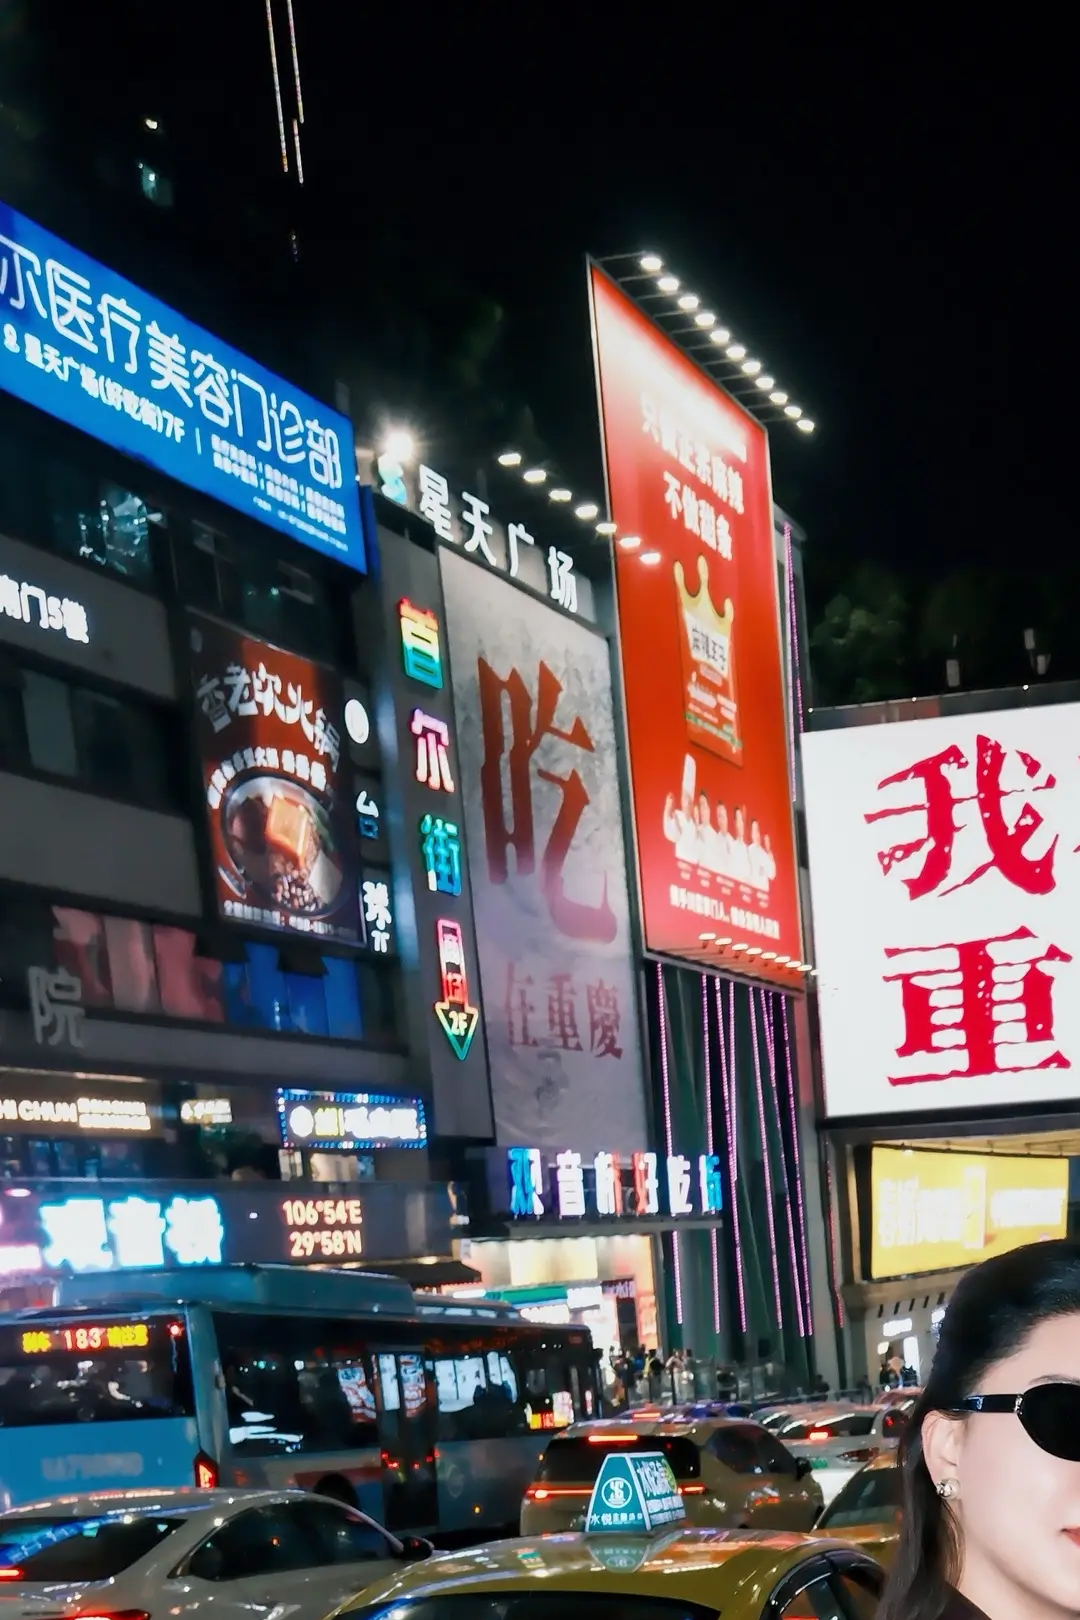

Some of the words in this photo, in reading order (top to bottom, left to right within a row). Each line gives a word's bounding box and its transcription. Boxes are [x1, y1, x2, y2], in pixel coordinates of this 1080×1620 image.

[419, 463, 579, 614] 星天广场
[477, 656, 618, 944] 吃
[28, 965, 86, 1049] 院
